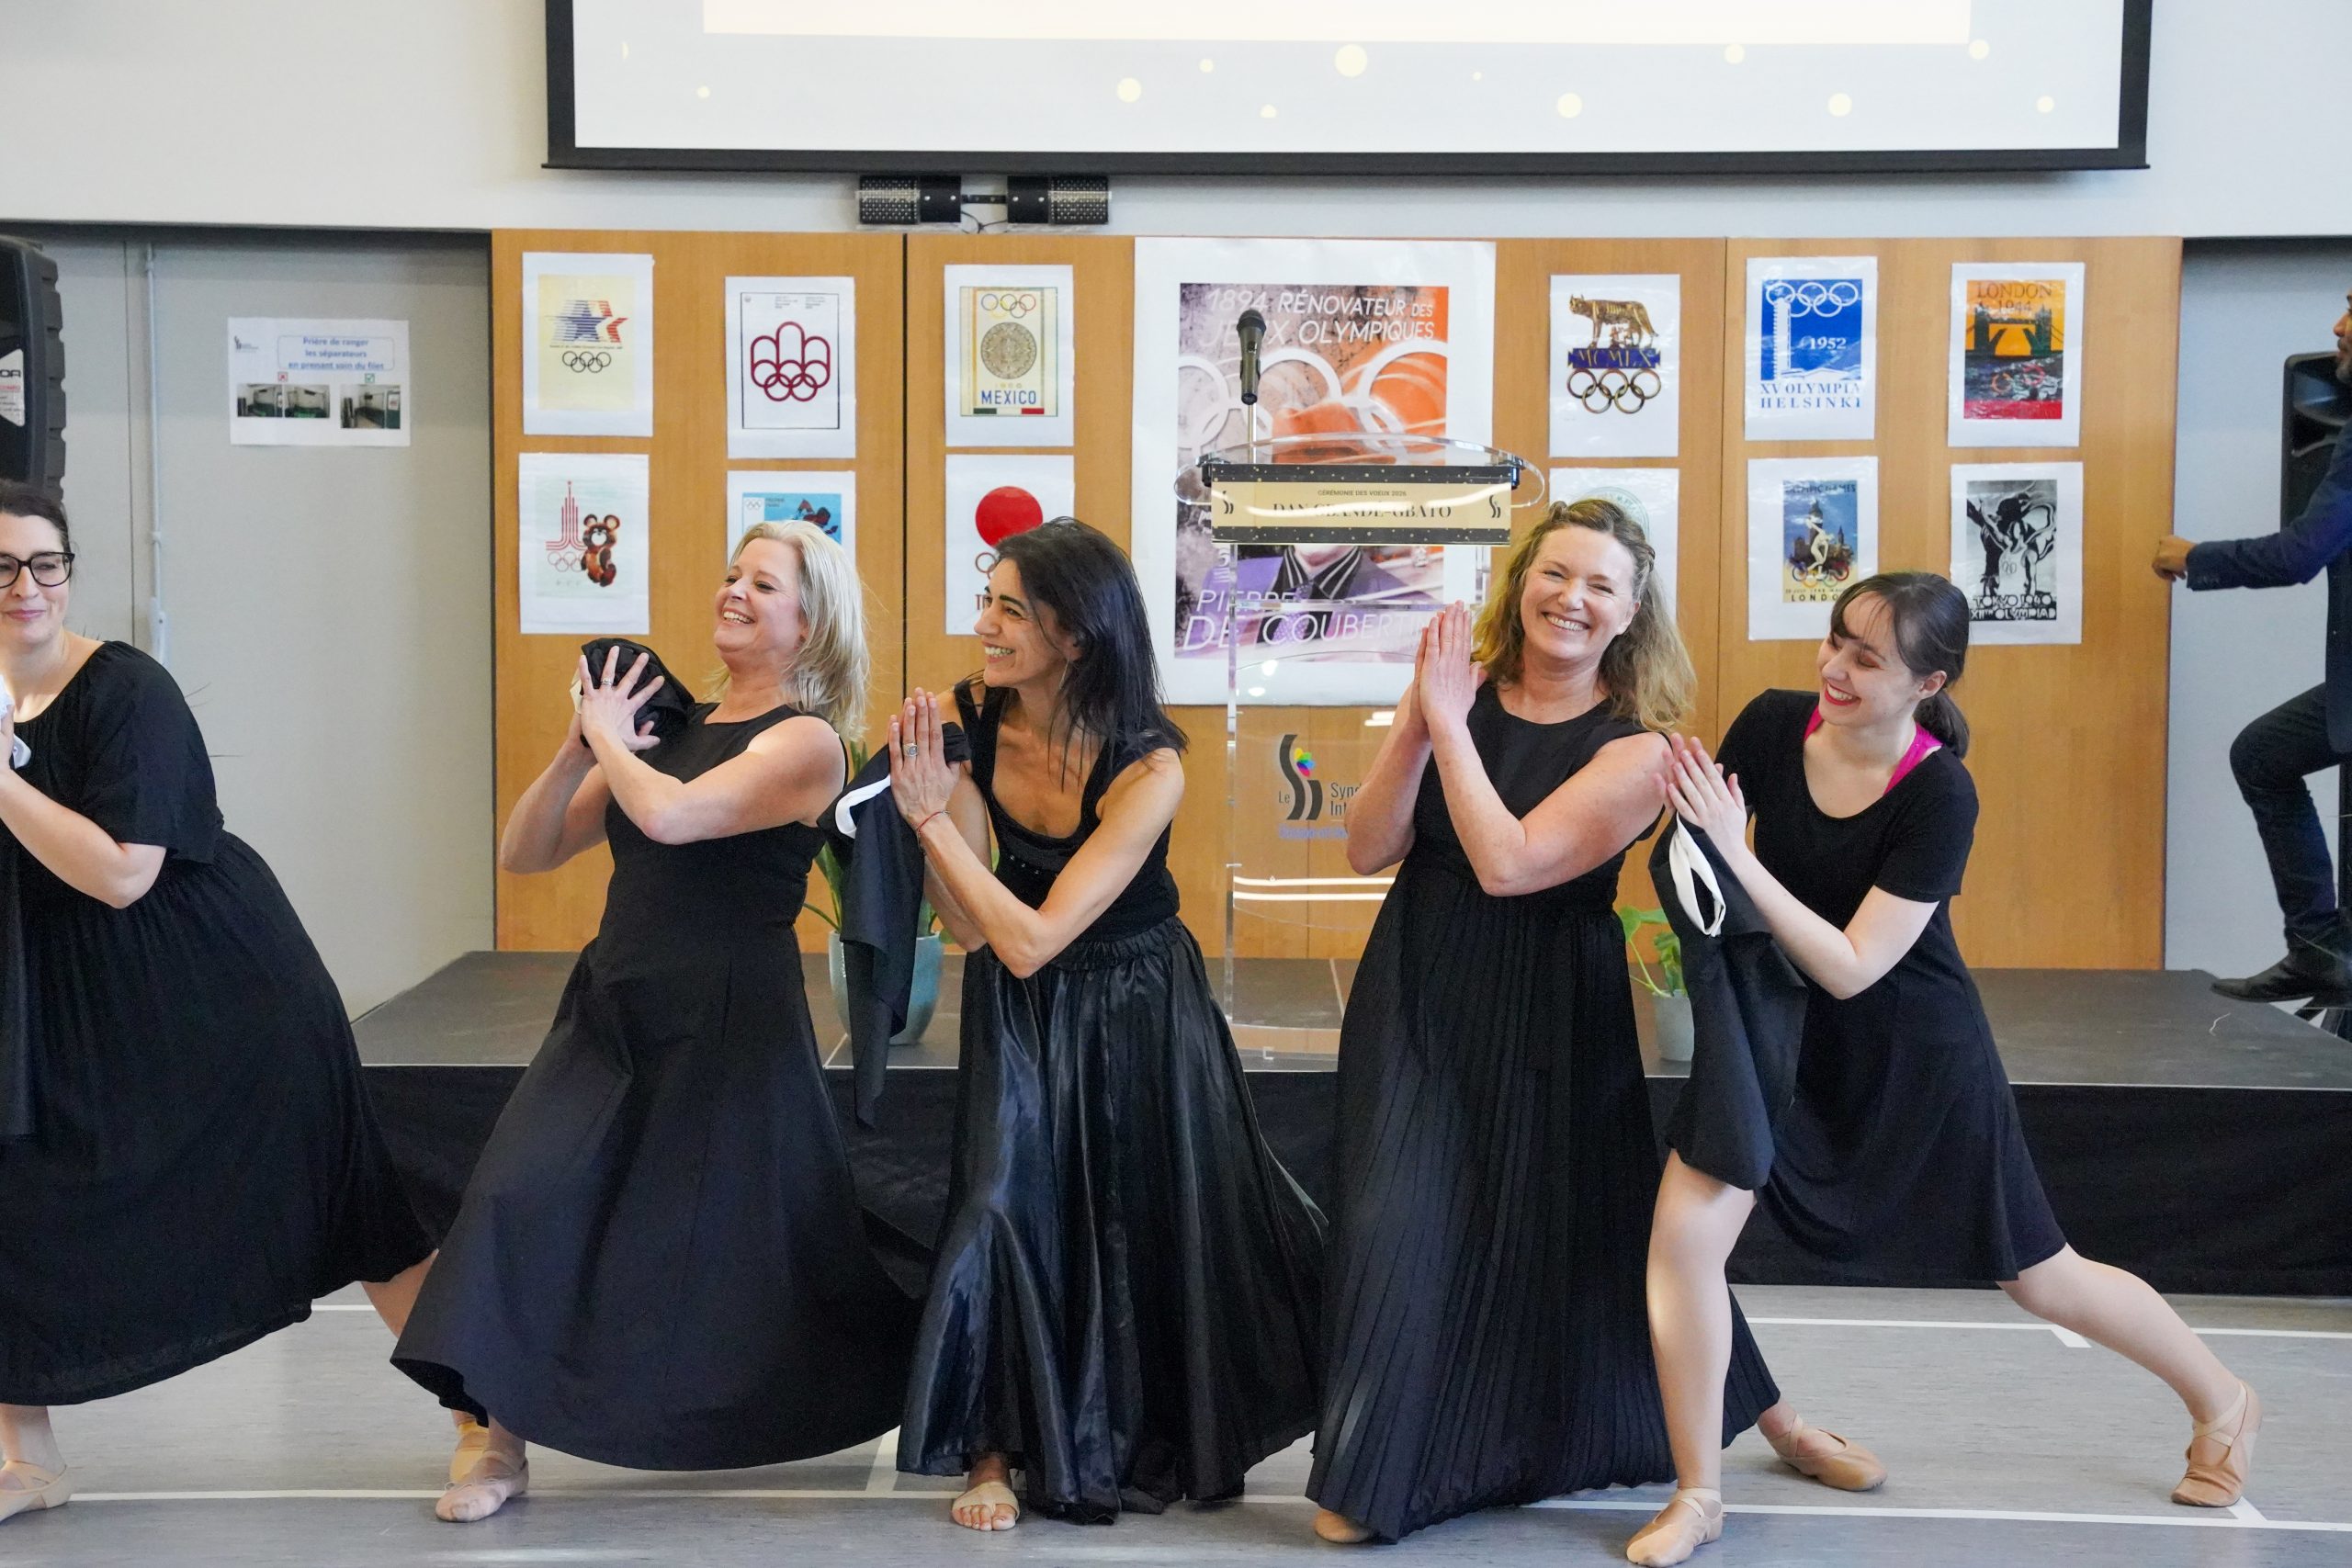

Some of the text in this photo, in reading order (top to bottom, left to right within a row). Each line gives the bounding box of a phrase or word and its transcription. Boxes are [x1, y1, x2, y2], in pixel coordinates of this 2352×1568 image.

[1977, 282, 2052, 299] LONDON
[1205, 288, 1433, 318] 1894 RÉNOVATEUR DES
[1198, 321, 1434, 347] JEX OLYMPIQUES
[1809, 336, 1847, 350] 1952
[1761, 383, 1781, 395] XV
[981, 390, 1036, 404] MEXICO
[1761, 398, 1861, 409] HELSINKI
[1791, 593, 1838, 603] LONDO
[1994, 606, 2056, 621] OLYMPIAD
[1182, 615, 1247, 650] DE
